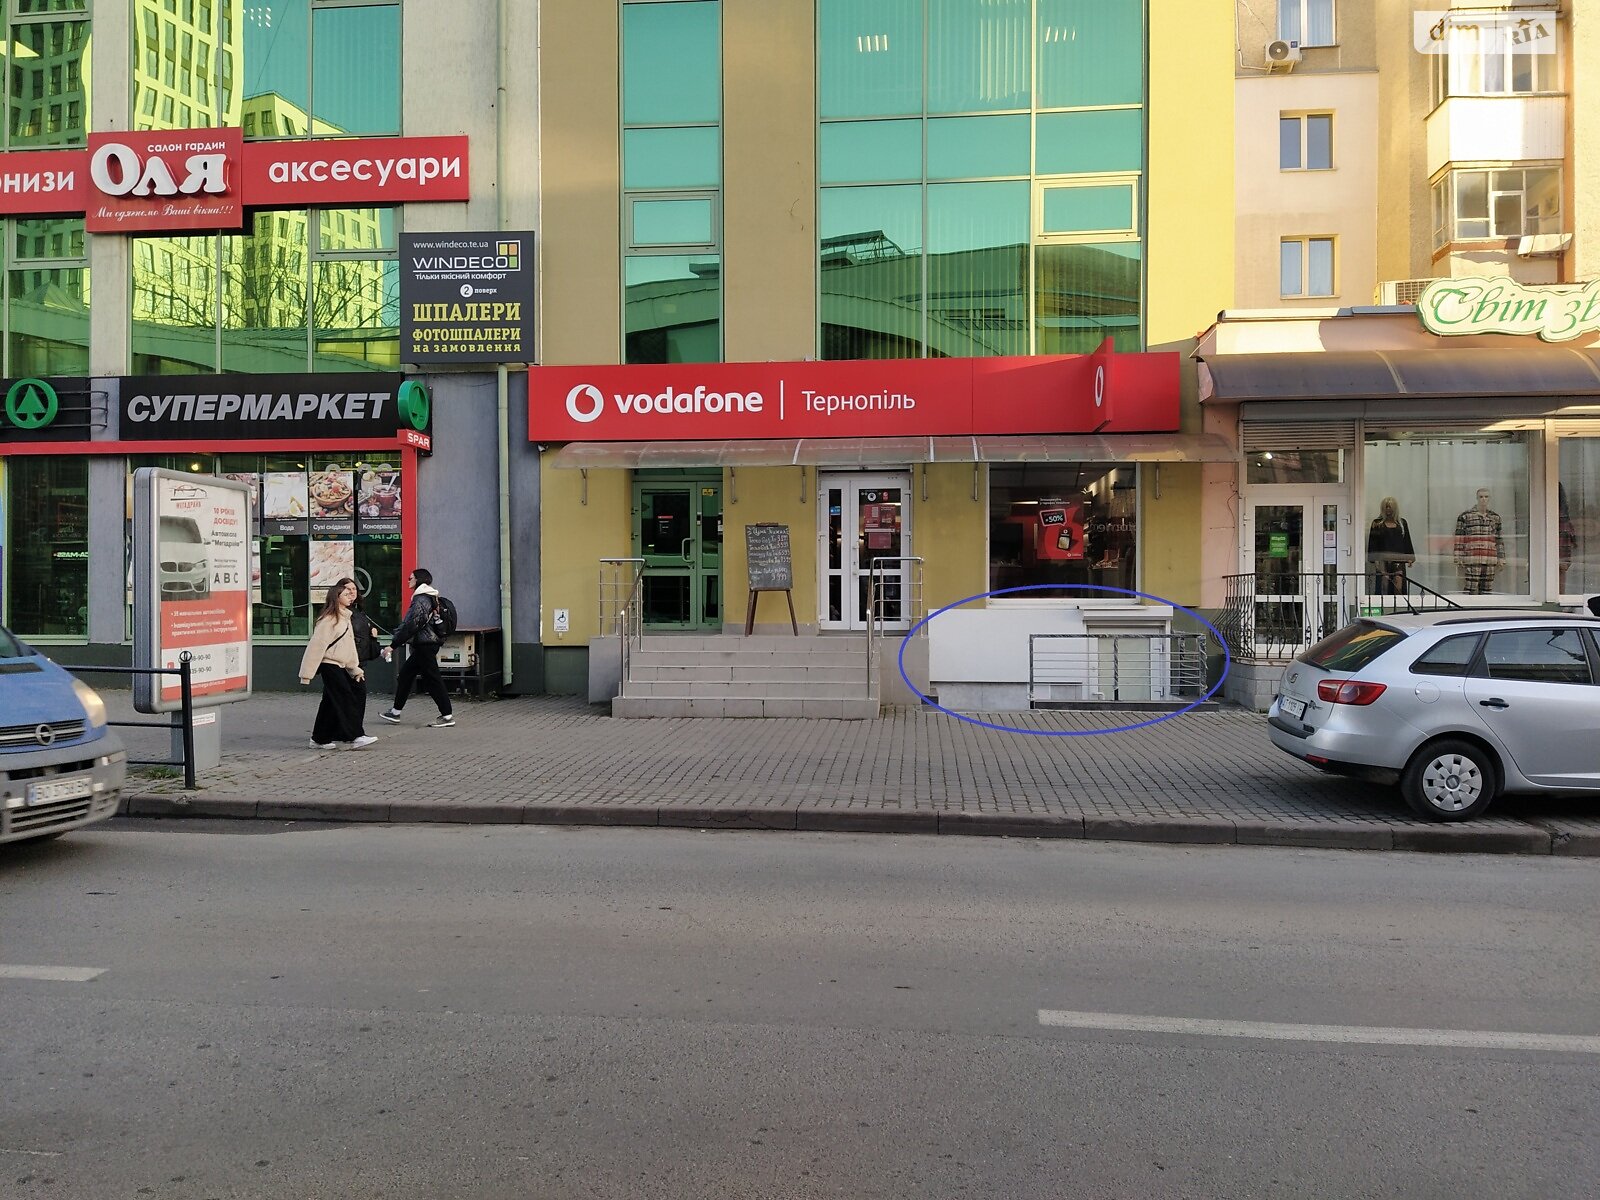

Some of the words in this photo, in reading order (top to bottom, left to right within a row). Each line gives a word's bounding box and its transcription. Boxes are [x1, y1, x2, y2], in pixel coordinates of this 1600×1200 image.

[147, 143, 182, 153] салон
[184, 141, 226, 152] гардин
[90, 143, 228, 196] Оля
[268, 156, 460, 187] аксесуари
[0, 171, 74, 194] низи
[162, 204, 191, 216] Ваші
[413, 241, 489, 249] www.windeco.te.ua
[412, 256, 508, 269] WINDECO
[440, 272, 470, 280] якісний
[471, 272, 507, 281] комфорт
[412, 302, 521, 322] ШПАЛЕРИ
[412, 327, 521, 341] ФОТОШПАЛЕРИ
[413, 344, 430, 353] на
[433, 343, 521, 353] замовлення
[613, 385, 763, 414] vodafone
[801, 389, 916, 416] Тернопіль
[127, 392, 391, 422] СУПЕРМАРКЕТ
[406, 432, 430, 448] SPAR
[279, 524, 295, 532] Вода
[362, 523, 397, 531] Консервація
[213, 572, 221, 584] A
[223, 572, 231, 584] B
